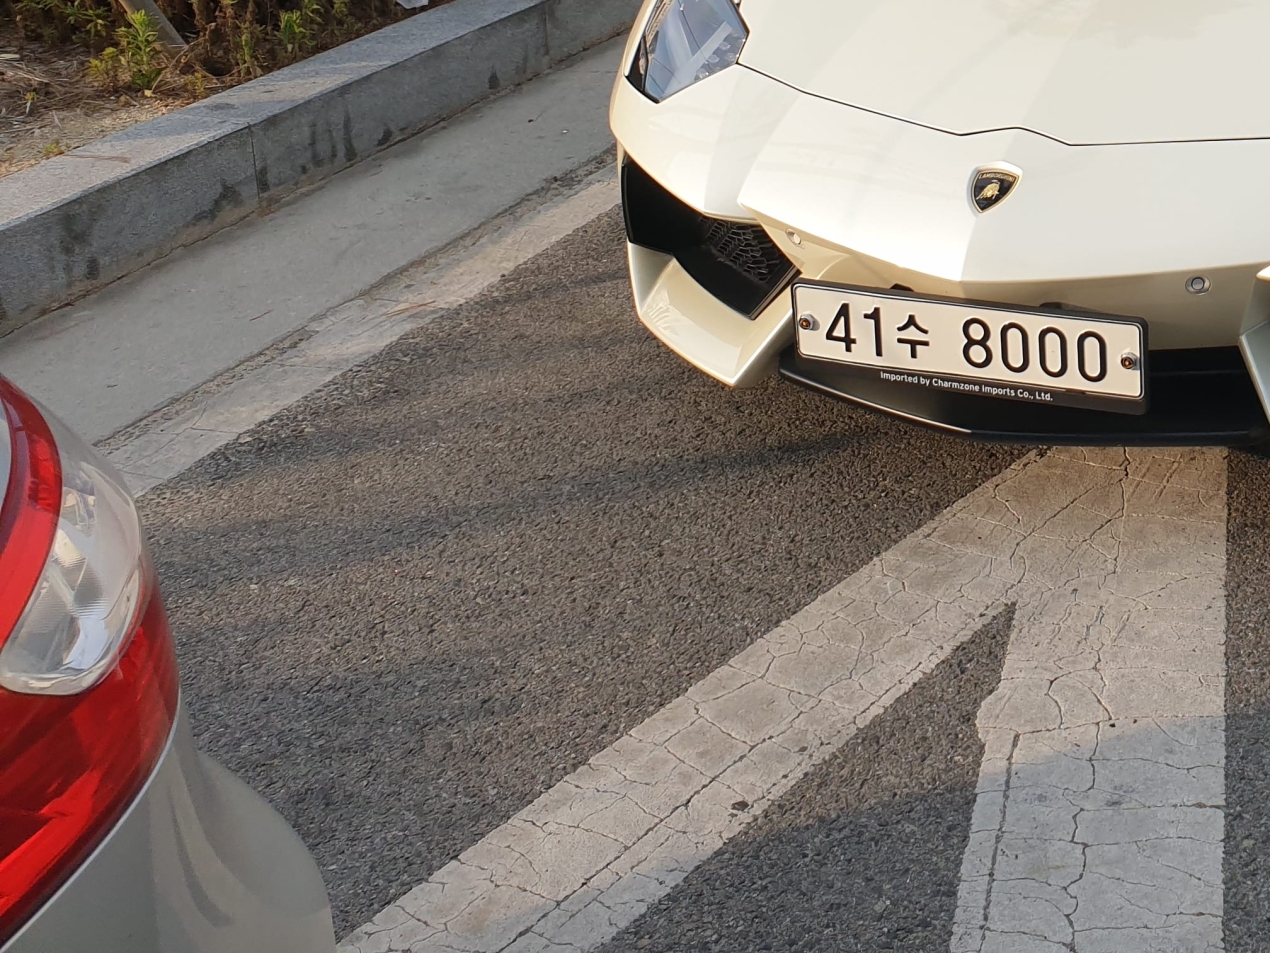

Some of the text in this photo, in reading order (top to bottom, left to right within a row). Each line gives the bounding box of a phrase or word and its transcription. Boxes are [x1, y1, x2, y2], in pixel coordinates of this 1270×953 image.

[825, 302, 1107, 383] 41수 8000
[880, 370, 1054, 402] Imported by Charmzone Imports Co., Ltd.
